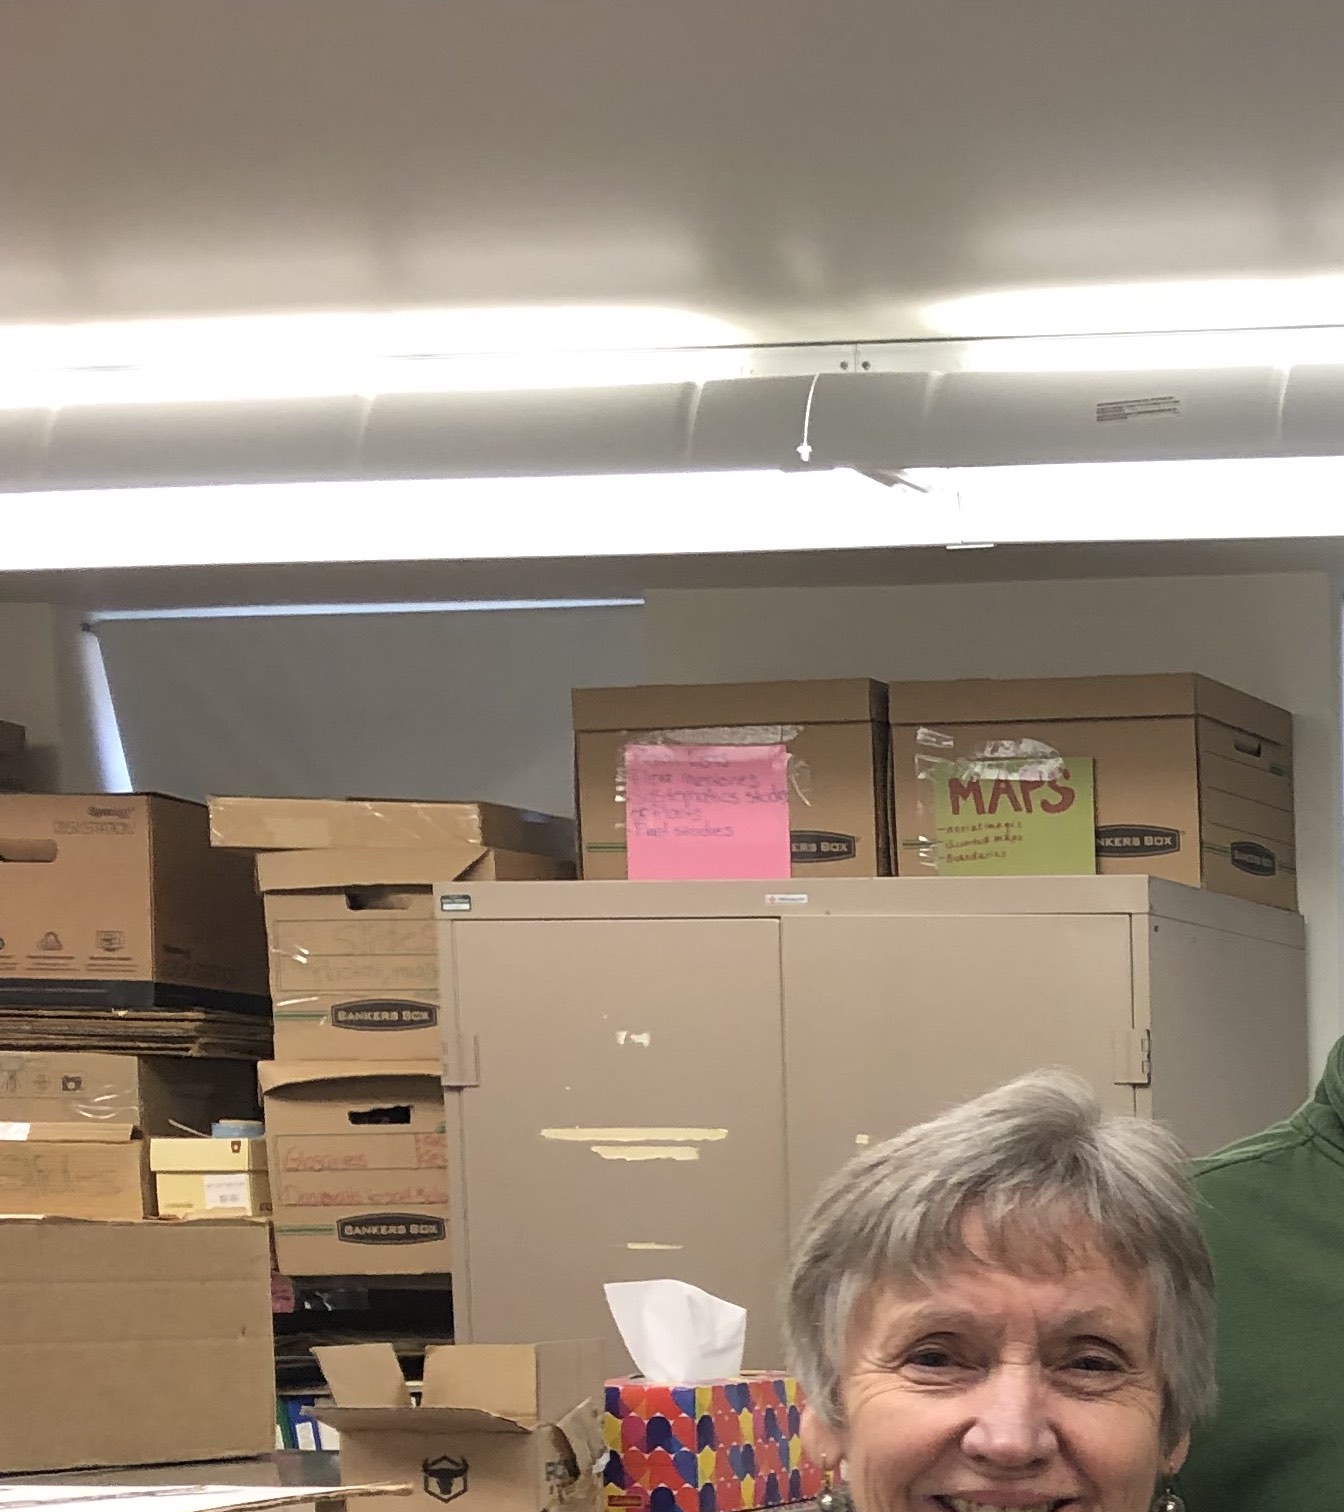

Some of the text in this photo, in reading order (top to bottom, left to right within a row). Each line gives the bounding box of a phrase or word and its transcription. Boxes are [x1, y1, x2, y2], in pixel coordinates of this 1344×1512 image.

[948, 768, 1075, 815] MAPS
[820, 841, 848, 852] BOX
[1099, 835, 1174, 847] NKERS BOX
[337, 1010, 430, 1021] BANKERS BOX
[344, 1223, 439, 1235] BANKERS BOX
